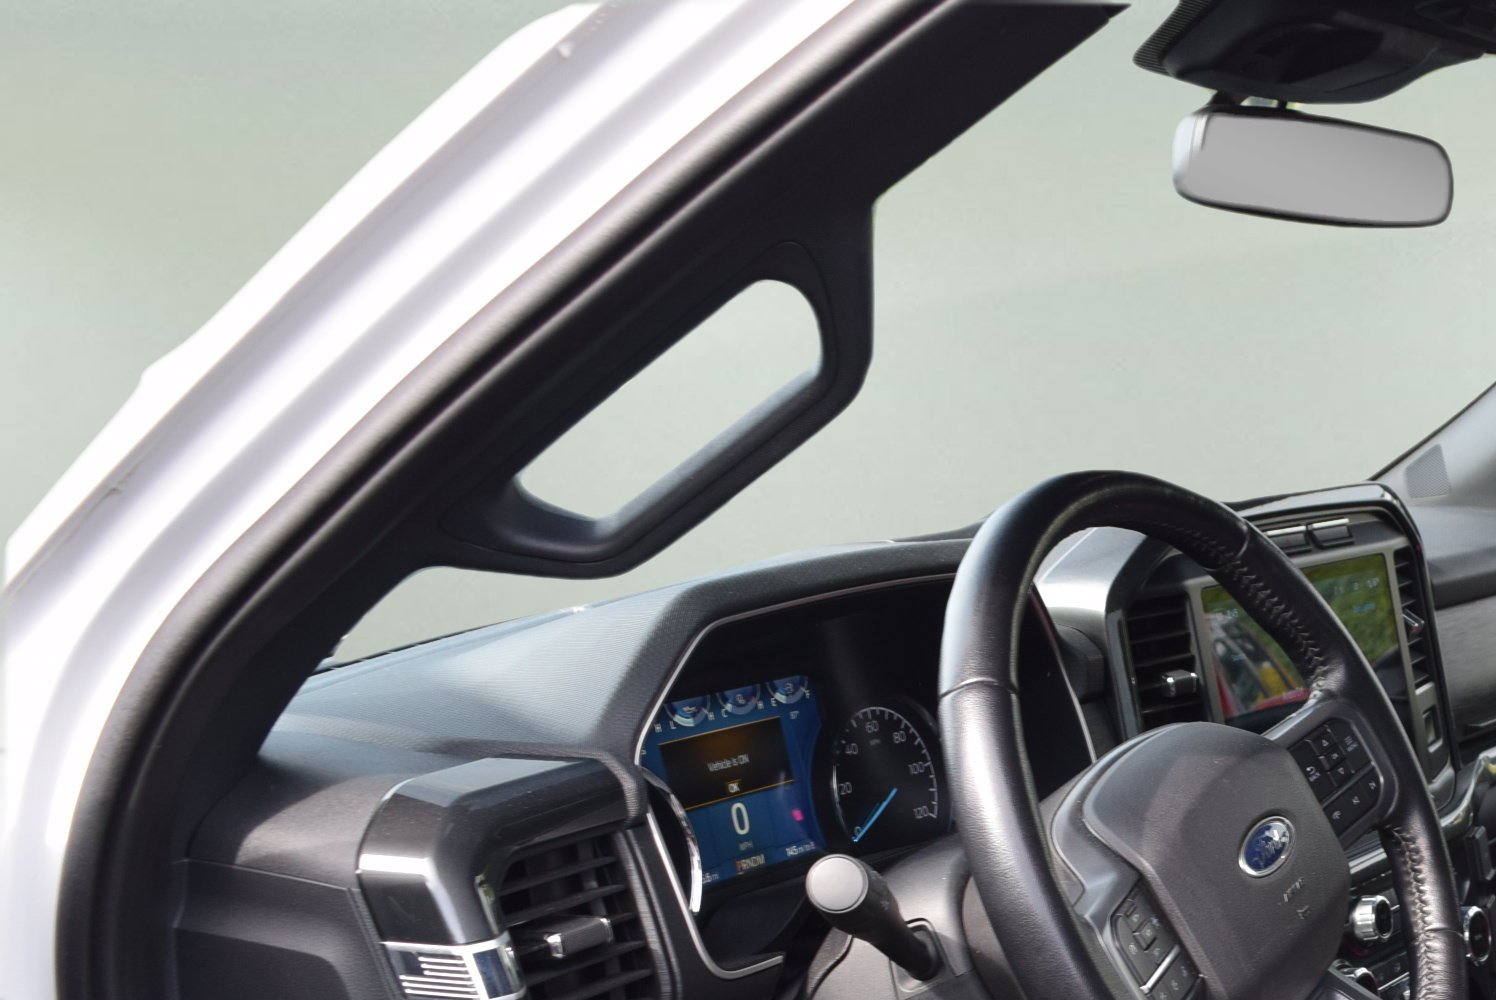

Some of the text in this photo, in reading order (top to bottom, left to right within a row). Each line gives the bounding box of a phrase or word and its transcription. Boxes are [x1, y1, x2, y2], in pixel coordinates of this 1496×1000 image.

[865, 721, 879, 733] 60
[892, 731, 906, 743] 80
[845, 743, 858, 754] 40
[707, 758, 731, 772] Vehicle
[737, 754, 749, 765] ON
[908, 761, 924, 775] 100
[728, 782, 740, 793] OK
[840, 781, 852, 795] 20
[731, 802, 750, 835] 0
[913, 806, 928, 819] 120
